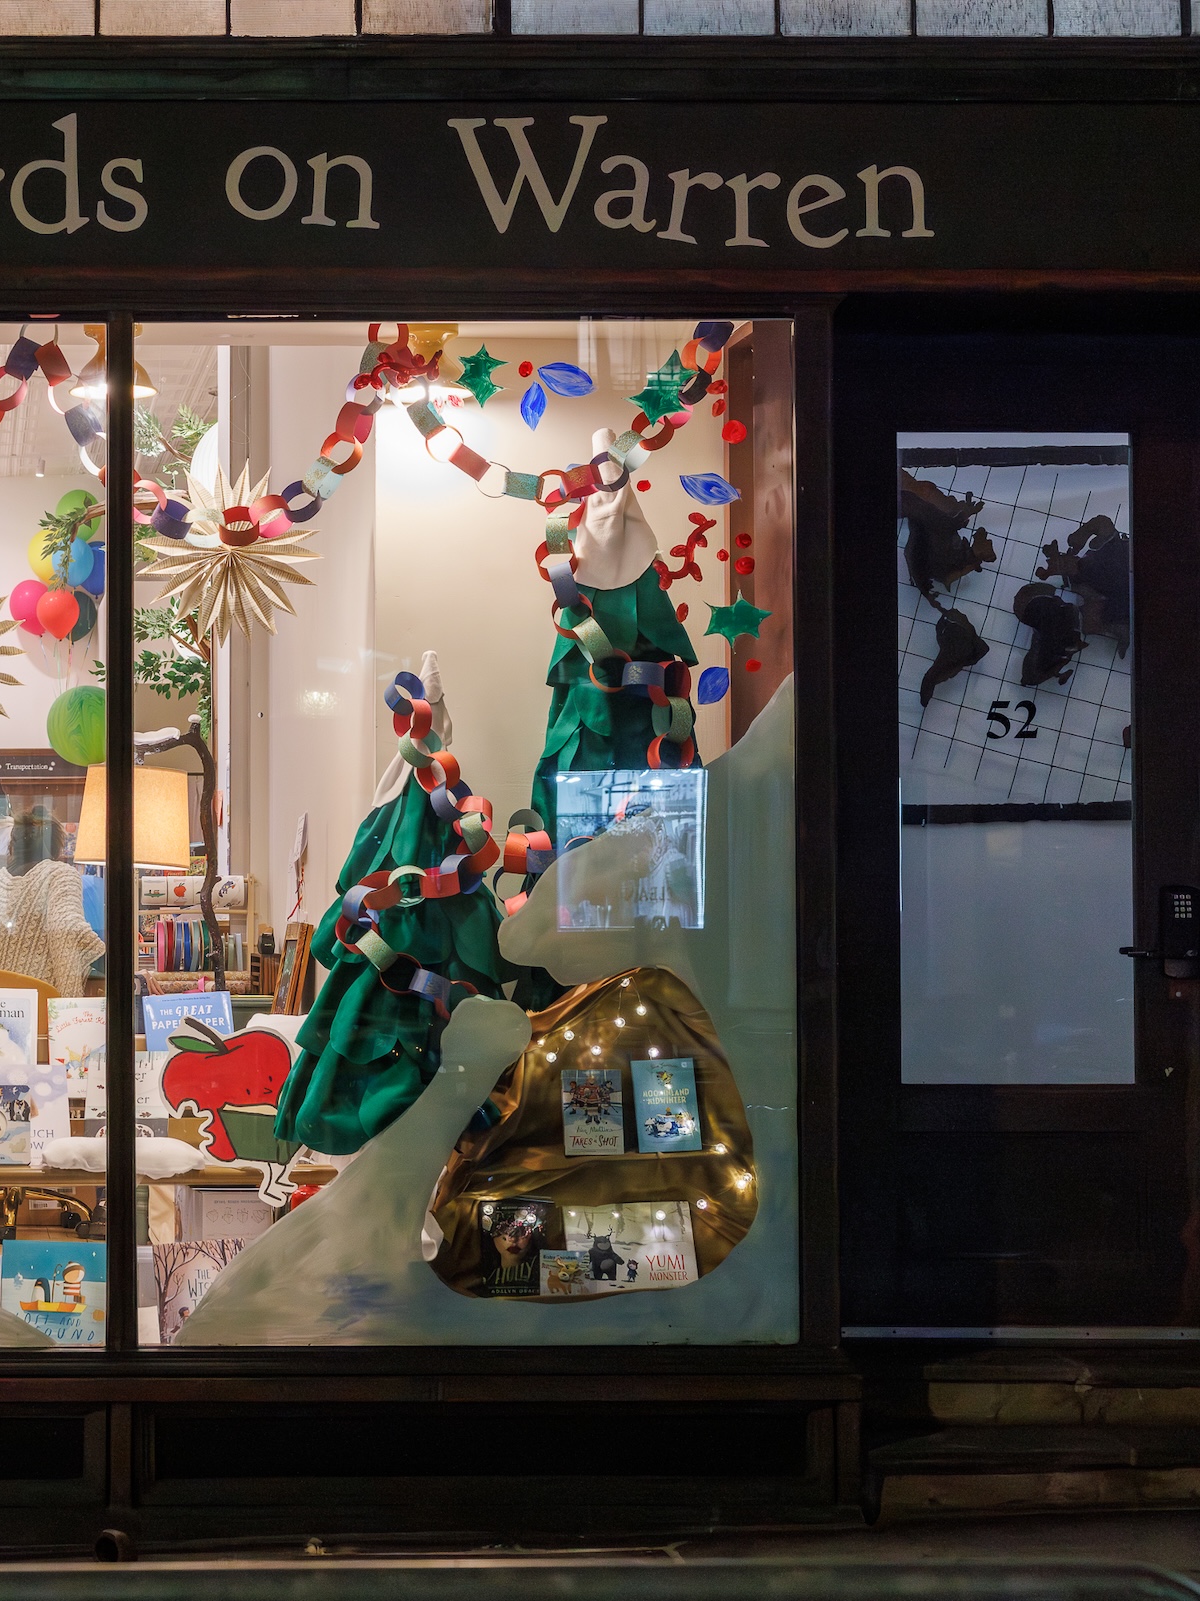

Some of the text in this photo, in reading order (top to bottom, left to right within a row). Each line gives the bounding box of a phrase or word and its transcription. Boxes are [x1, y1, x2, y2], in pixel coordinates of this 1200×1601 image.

[224, 144, 381, 230] on
[446, 114, 936, 249] Warren
[986, 700, 1039, 740] 52
[5, 762, 48, 771] Transportation
[159, 1004, 213, 1017] THE GREAT
[151, 1020, 181, 1031] PAPE
[598, 1134, 619, 1148] SHOT
[645, 1254, 686, 1271] YUMI
[196, 1268, 211, 1279] THE
[649, 1271, 689, 1281] MONSTER
[187, 1279, 214, 1298] WIS
[15, 1312, 81, 1327] OST AND
[36, 1326, 96, 1341] OUND
